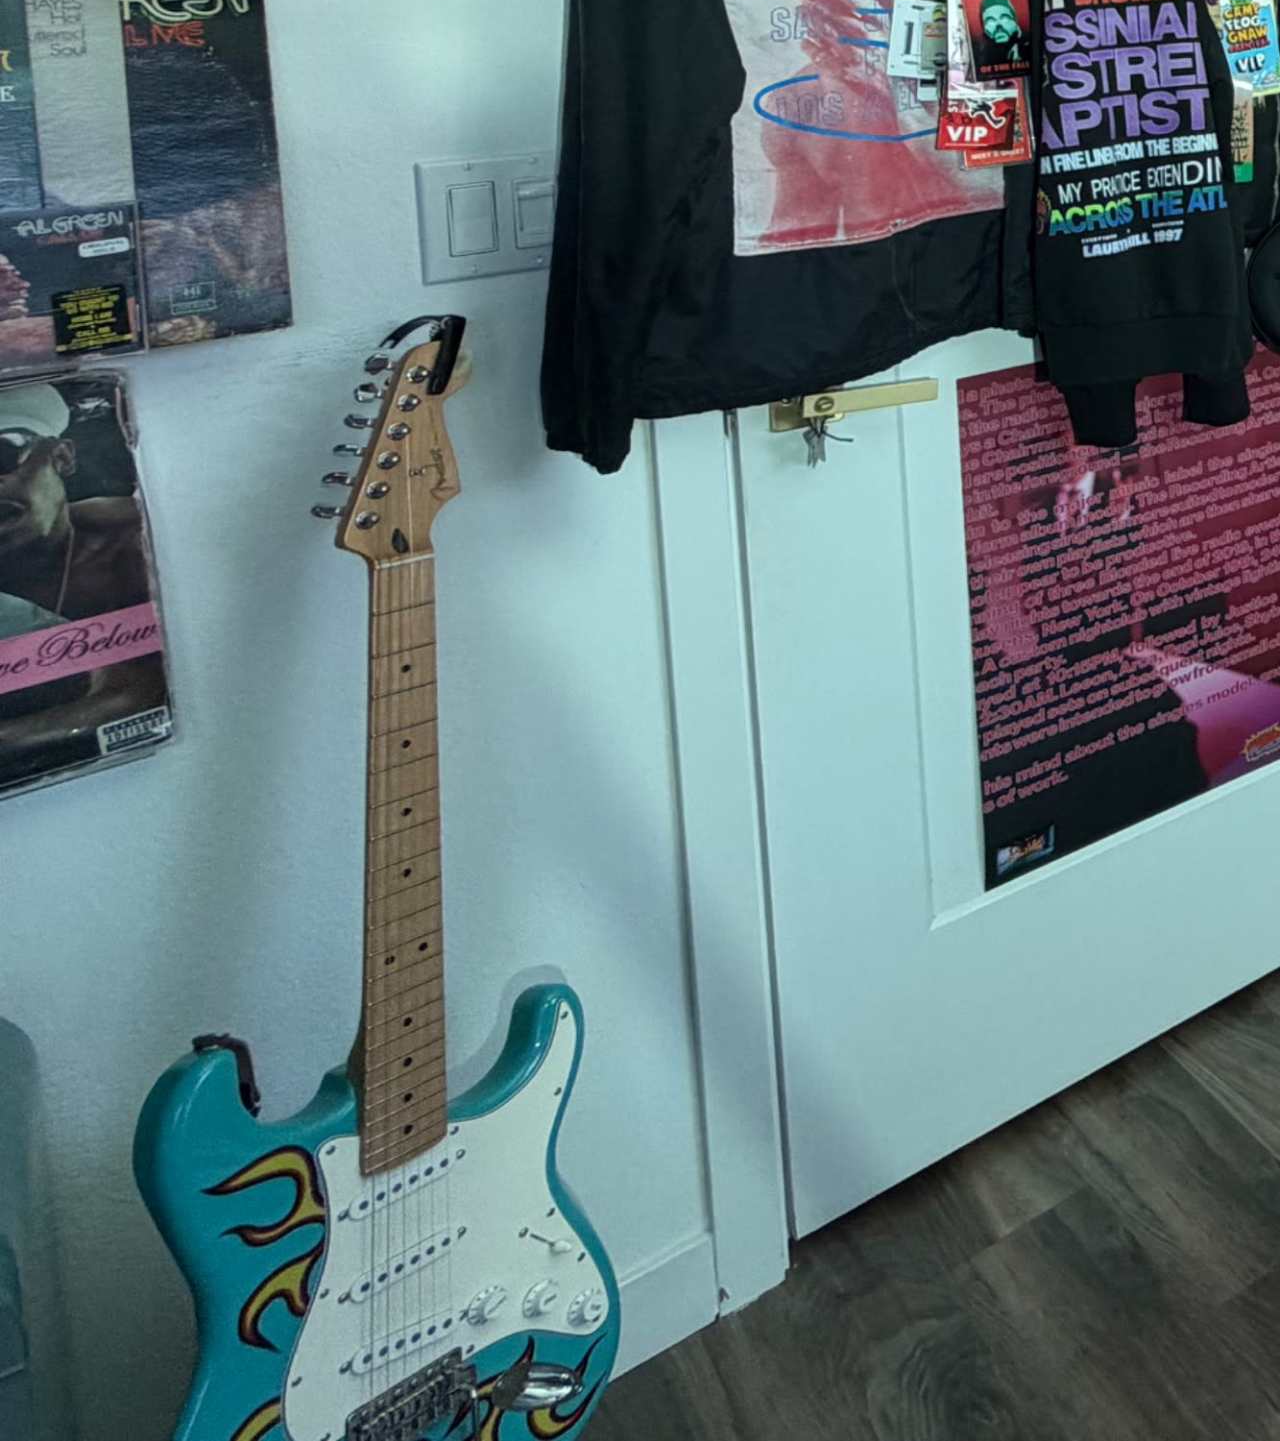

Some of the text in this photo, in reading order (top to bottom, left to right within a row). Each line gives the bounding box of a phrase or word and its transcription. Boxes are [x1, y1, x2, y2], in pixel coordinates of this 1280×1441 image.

[1236, 52, 1266, 73] VIP
[946, 125, 989, 144] VIP
[1056, 181, 1083, 205] MY
[1135, 189, 1185, 220] THE
[1041, 612, 1082, 638] New
[37, 619, 159, 667] Below
